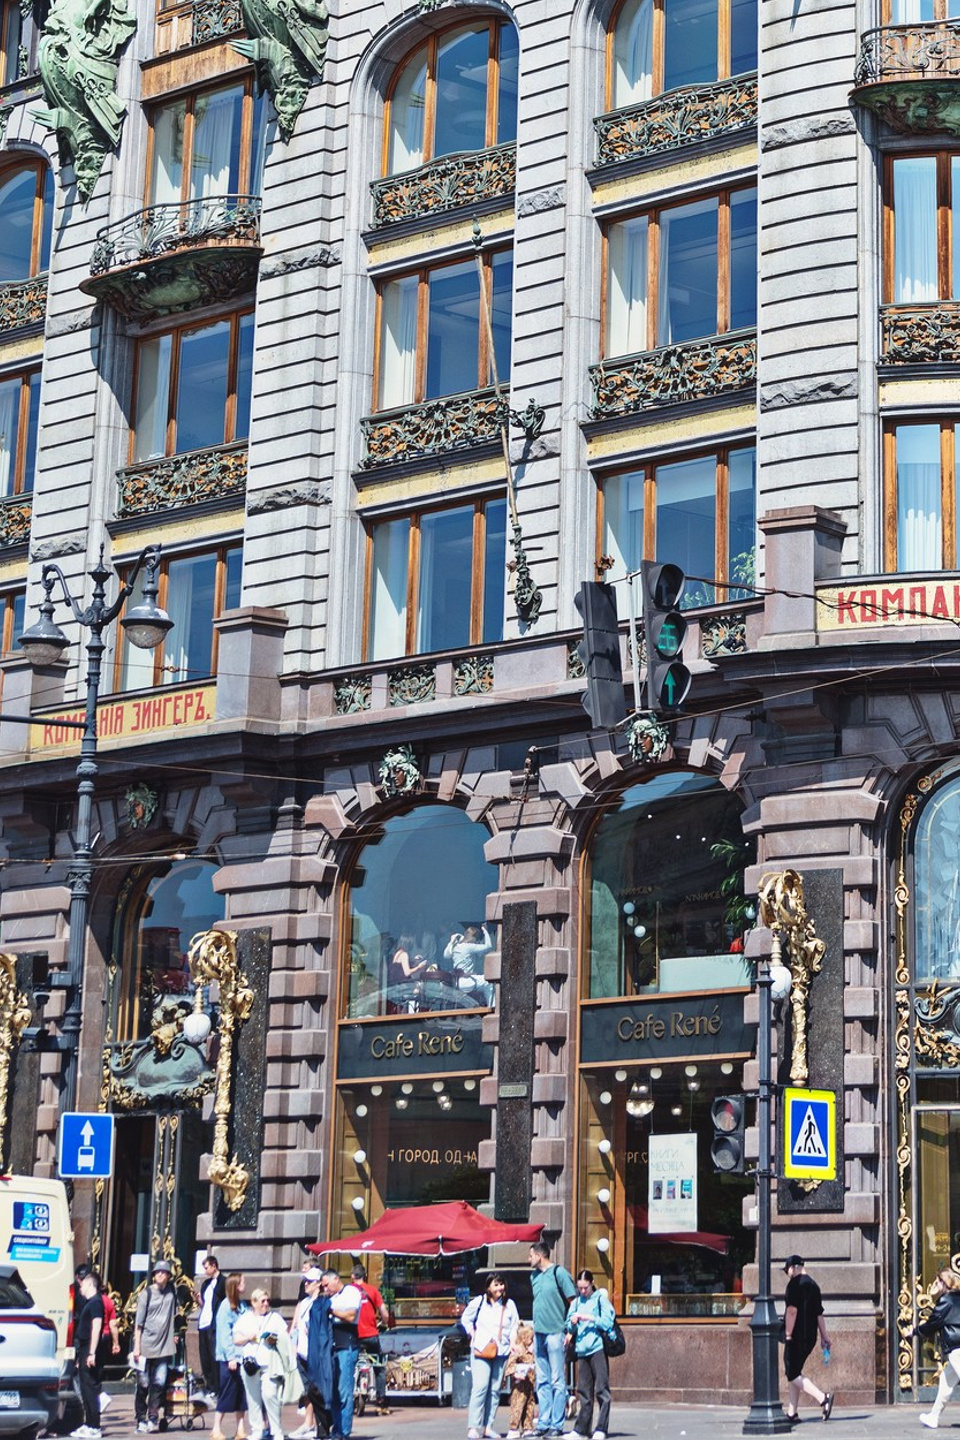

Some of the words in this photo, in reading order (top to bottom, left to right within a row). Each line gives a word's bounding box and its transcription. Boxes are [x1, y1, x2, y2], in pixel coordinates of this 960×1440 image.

[43, 705, 124, 746] КОМПНІЯ
[617, 1013, 666, 1040] Cafe
[670, 1005, 722, 1037] René
[370, 1033, 414, 1058] Cafe
[418, 1028, 465, 1056] René
